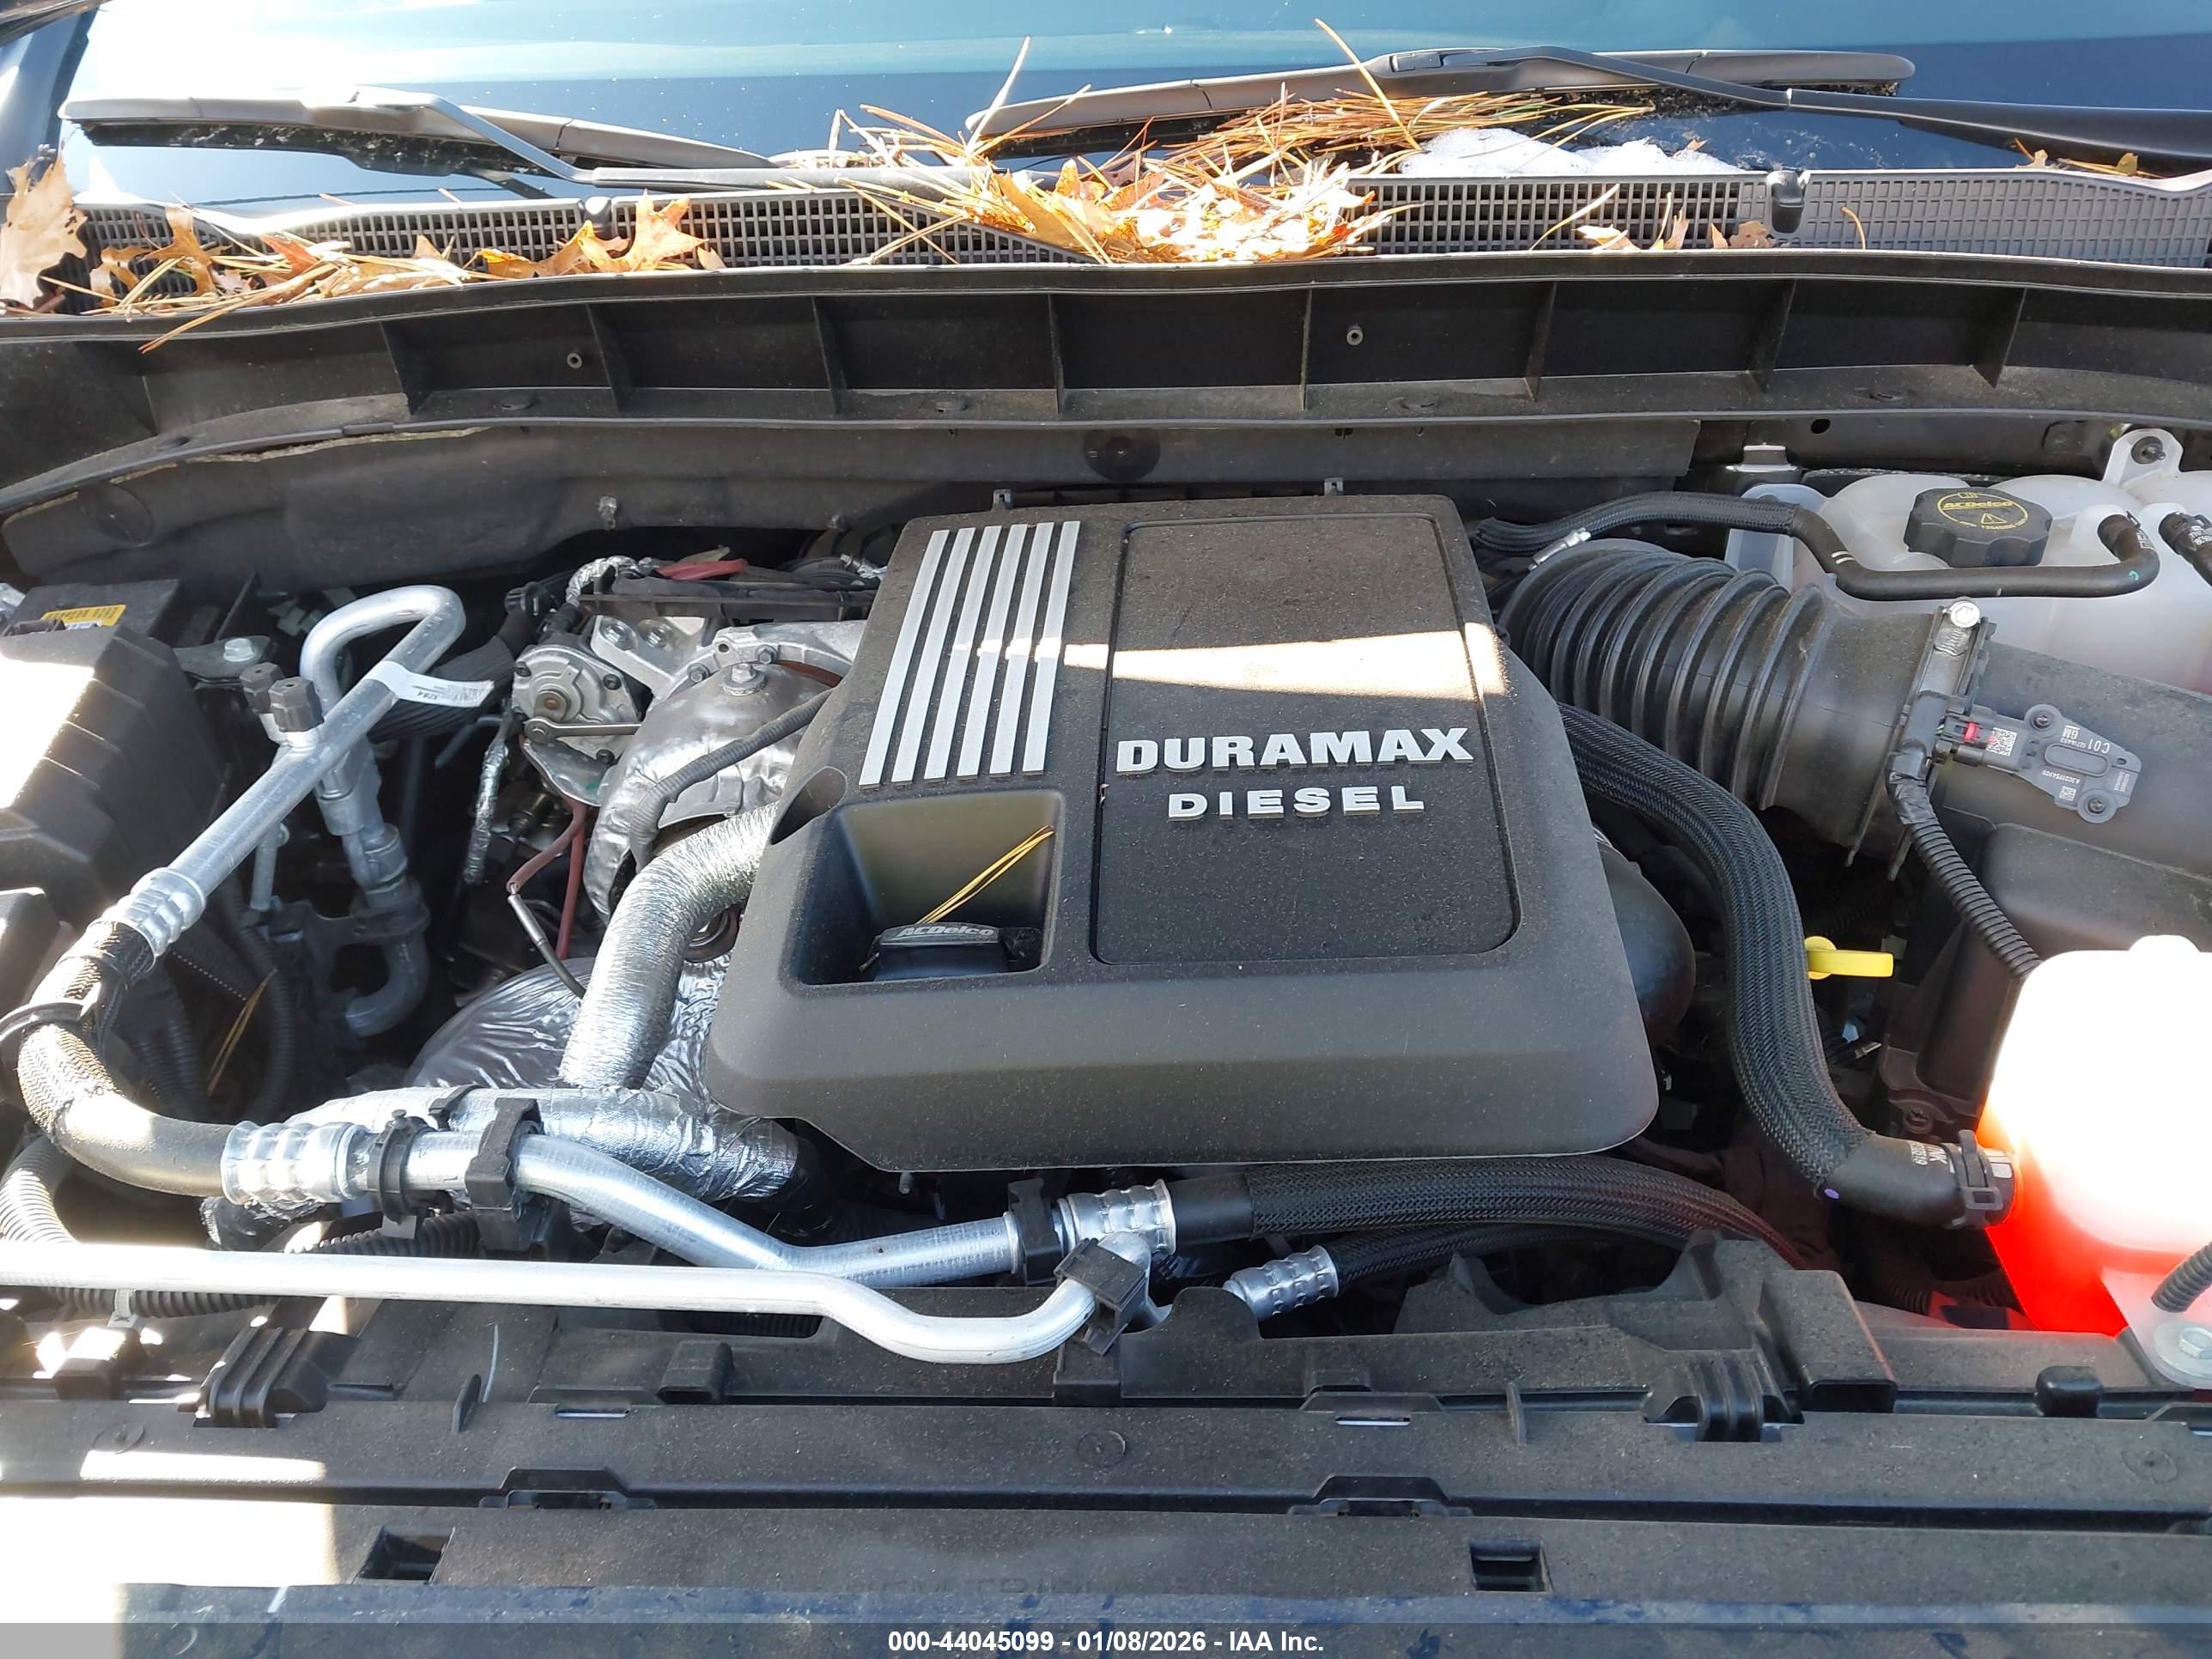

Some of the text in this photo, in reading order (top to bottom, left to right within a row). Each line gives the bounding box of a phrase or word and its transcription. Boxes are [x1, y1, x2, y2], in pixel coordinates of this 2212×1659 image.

[2062, 726, 2079, 739] GM
[1116, 727, 1474, 773] DURAMAX
[1168, 785, 1425, 823] DIESEL
[896, 926, 995, 938] ACDelco
